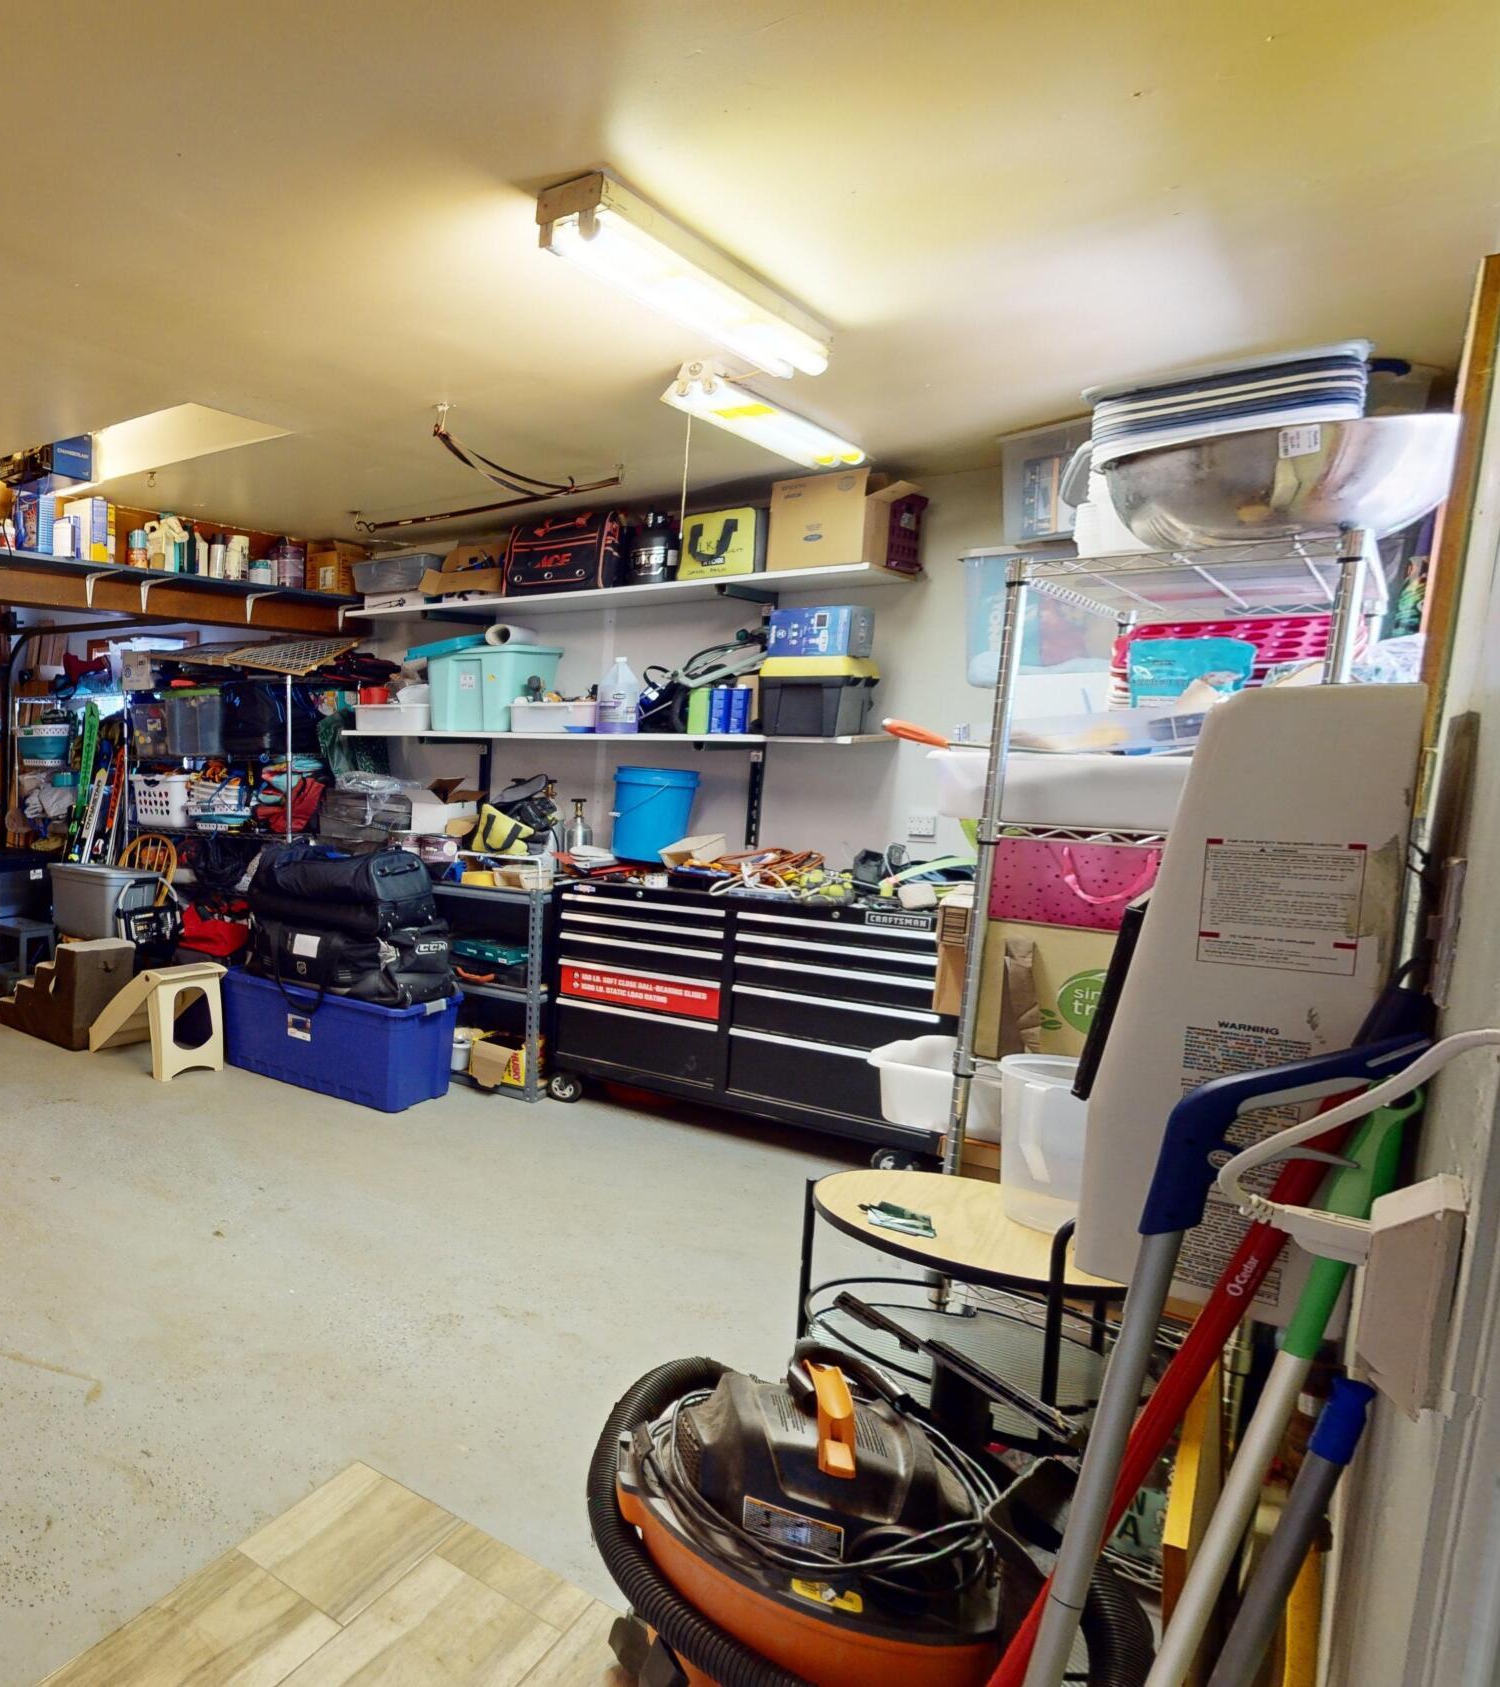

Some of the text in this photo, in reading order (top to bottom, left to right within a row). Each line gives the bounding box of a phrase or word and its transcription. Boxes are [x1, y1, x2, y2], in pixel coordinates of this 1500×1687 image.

[534, 552, 573, 569] ACE
[85, 779, 102, 831] DYNASTAR
[869, 914, 928, 928] CRAFTSMAN
[418, 943, 448, 952] CCM
[1218, 1021, 1280, 1036] WARNING
[511, 1052, 521, 1082] HUSKY
